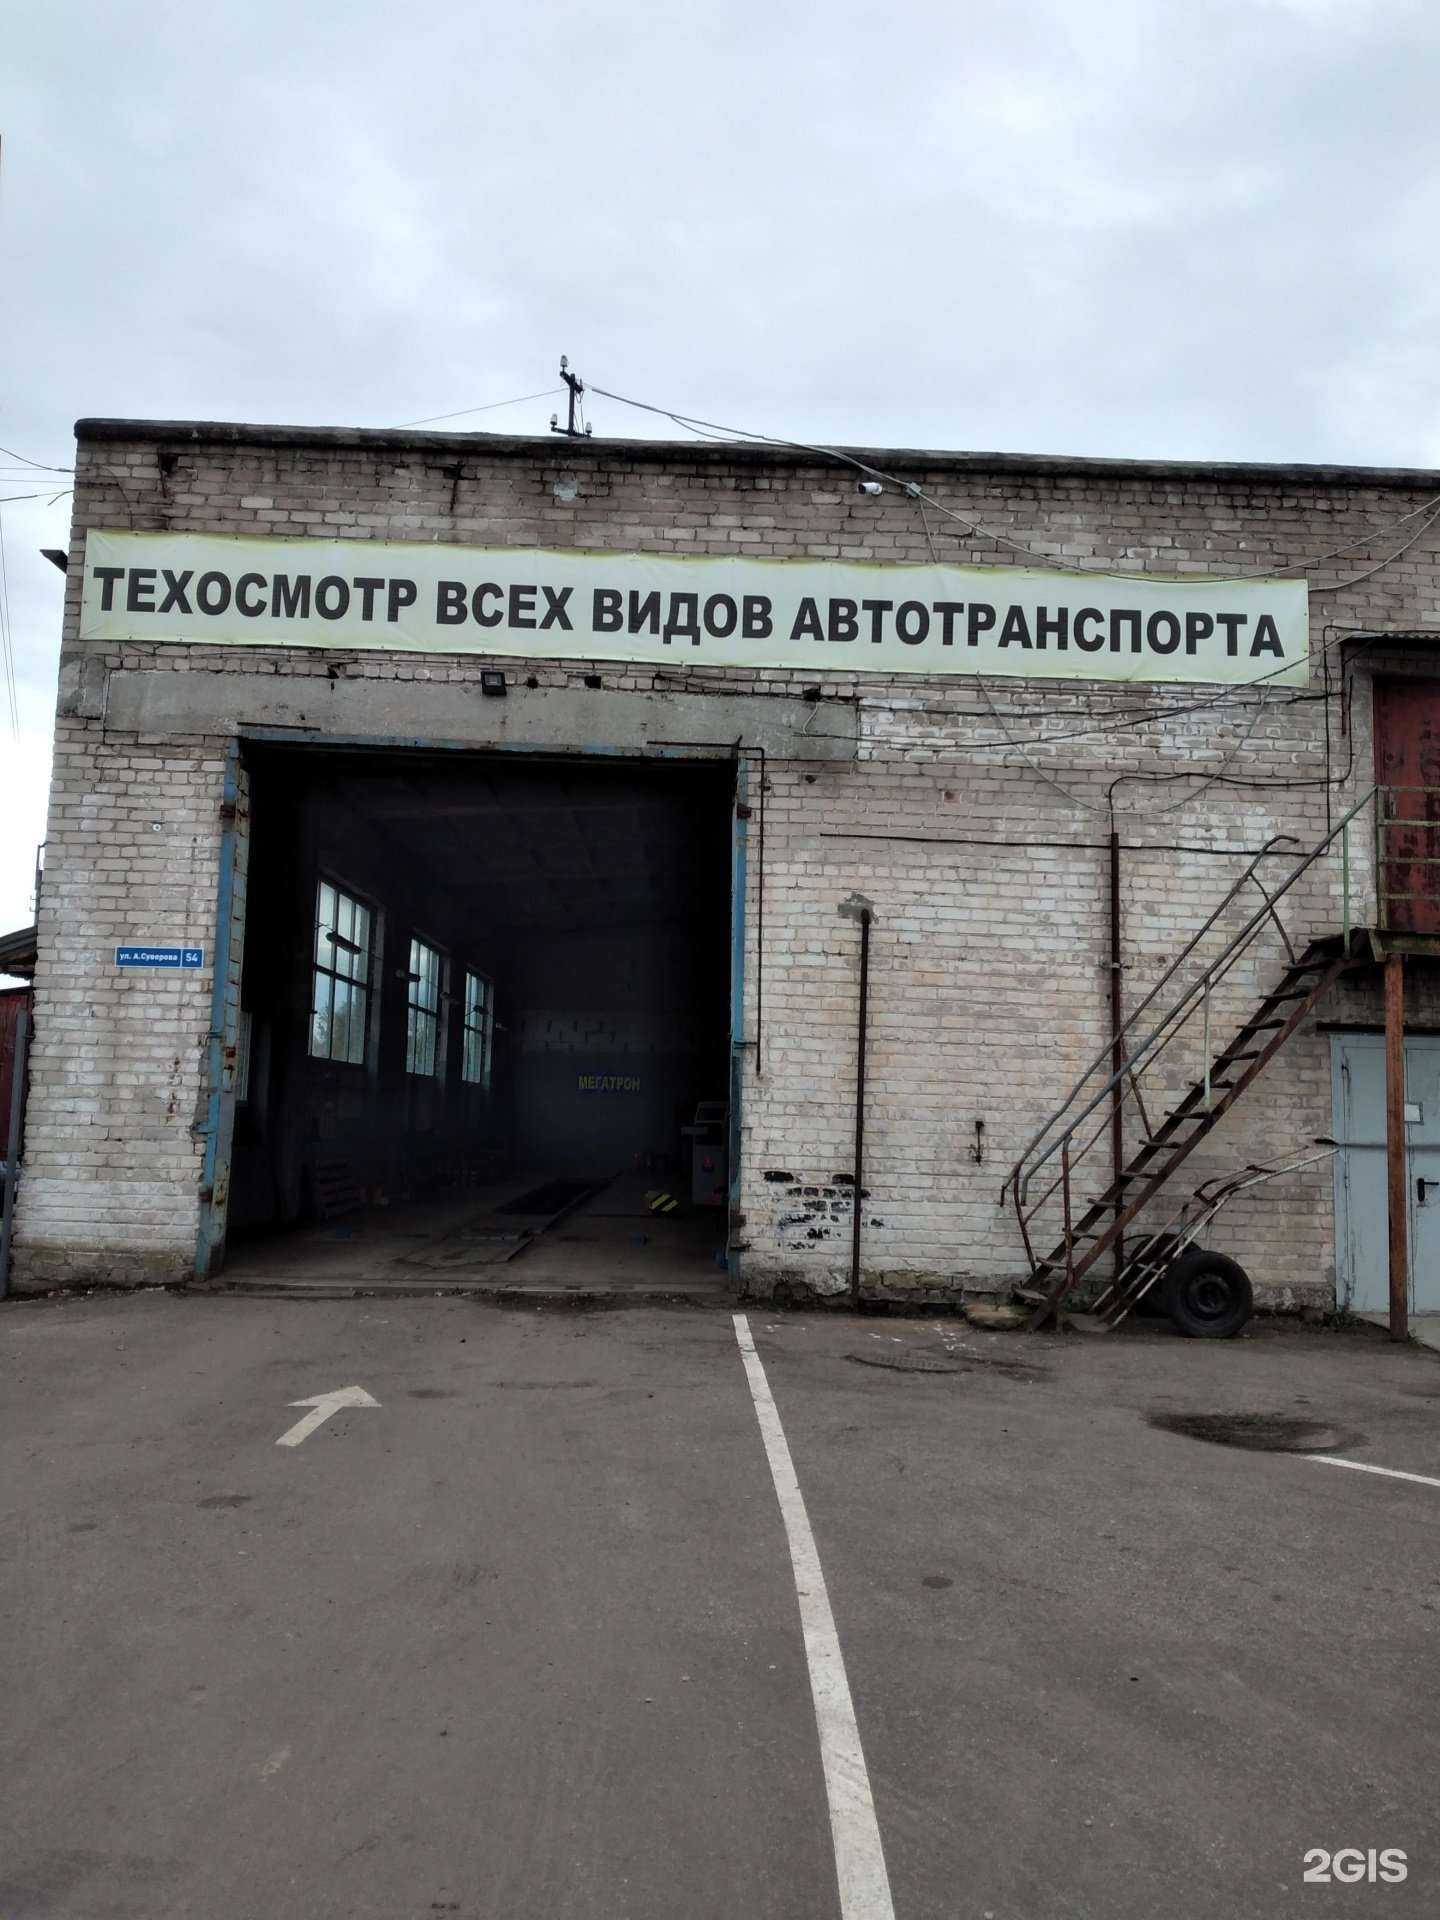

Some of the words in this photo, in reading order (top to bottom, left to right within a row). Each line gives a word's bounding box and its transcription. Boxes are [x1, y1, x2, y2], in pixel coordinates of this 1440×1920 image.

[93, 567, 417, 622] ТЕХОСМОТР
[436, 581, 574, 630] ВСЕХ
[592, 588, 773, 645] ВИДОВ
[790, 597, 1285, 657] АВТОТРАНСПОРТА
[185, 953, 198, 962] 54
[578, 1075, 641, 1091] МЕГАТРОН
